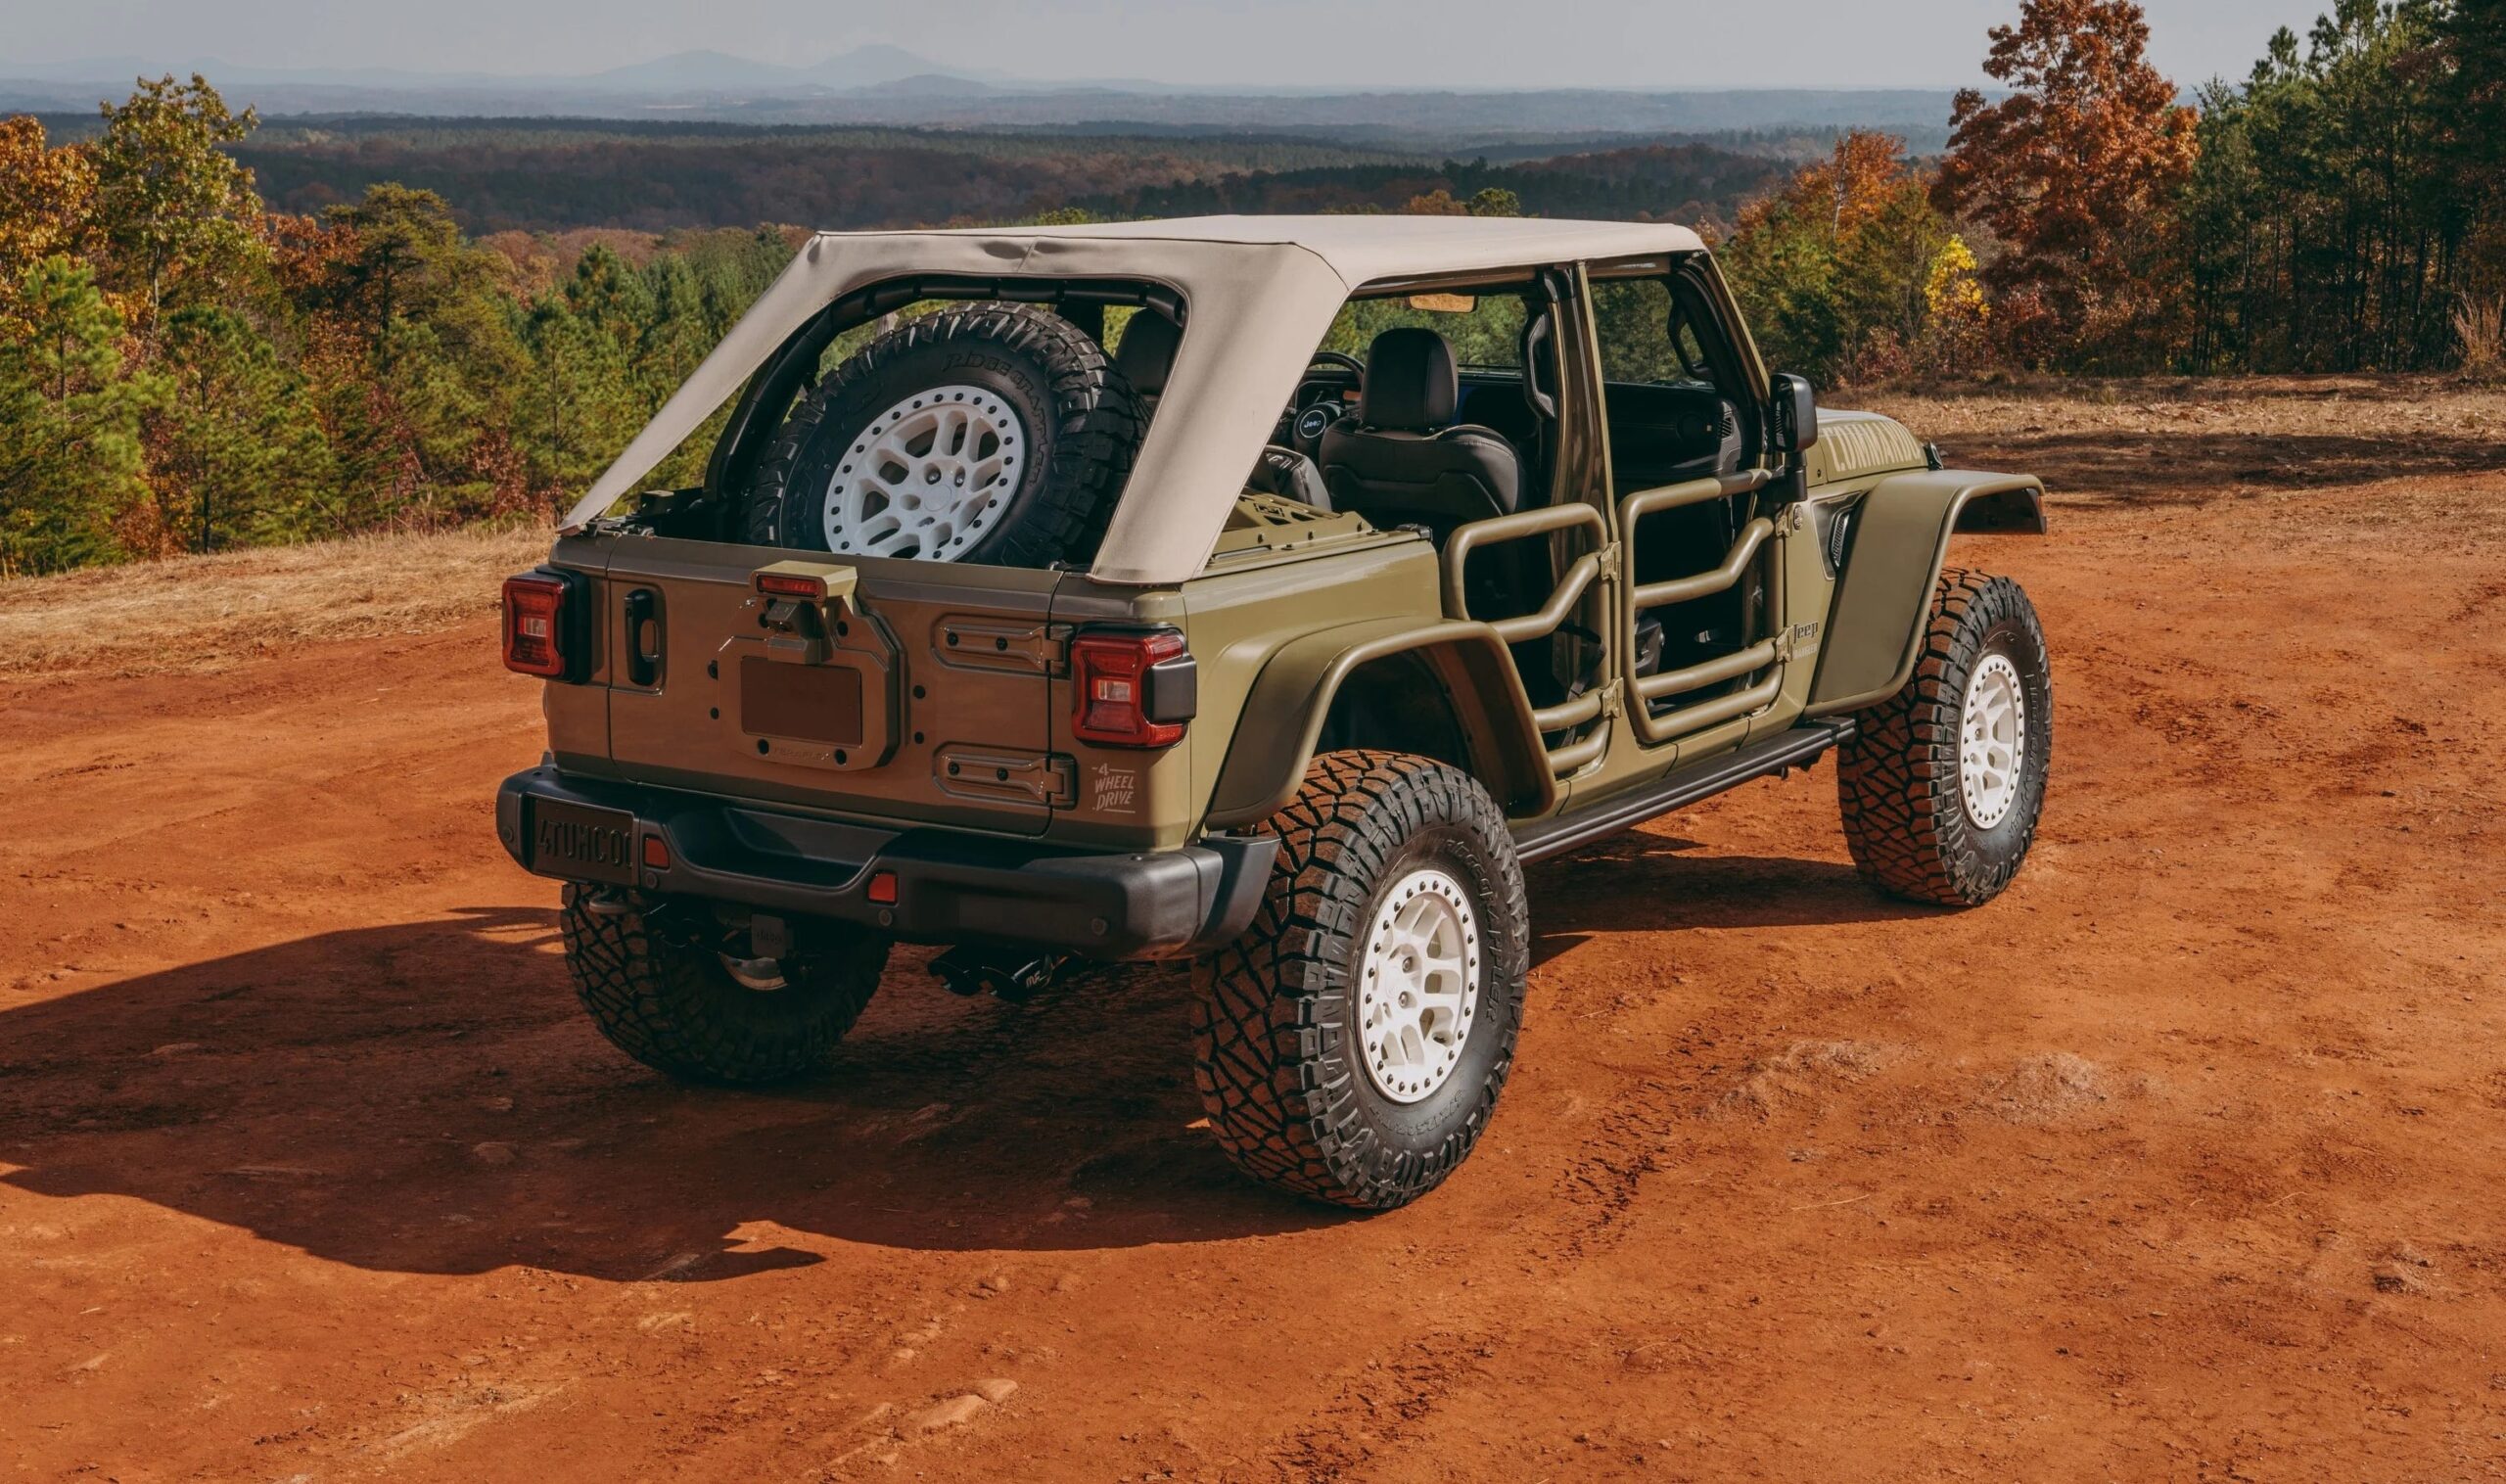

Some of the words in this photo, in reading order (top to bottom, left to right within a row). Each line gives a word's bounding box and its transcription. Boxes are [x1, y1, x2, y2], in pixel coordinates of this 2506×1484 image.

[1793, 622, 1819, 644] Jeep
[1098, 763, 1109, 775] 4
[1095, 775, 1134, 793] WHEEL
[1096, 791, 1135, 811] DRIVE
